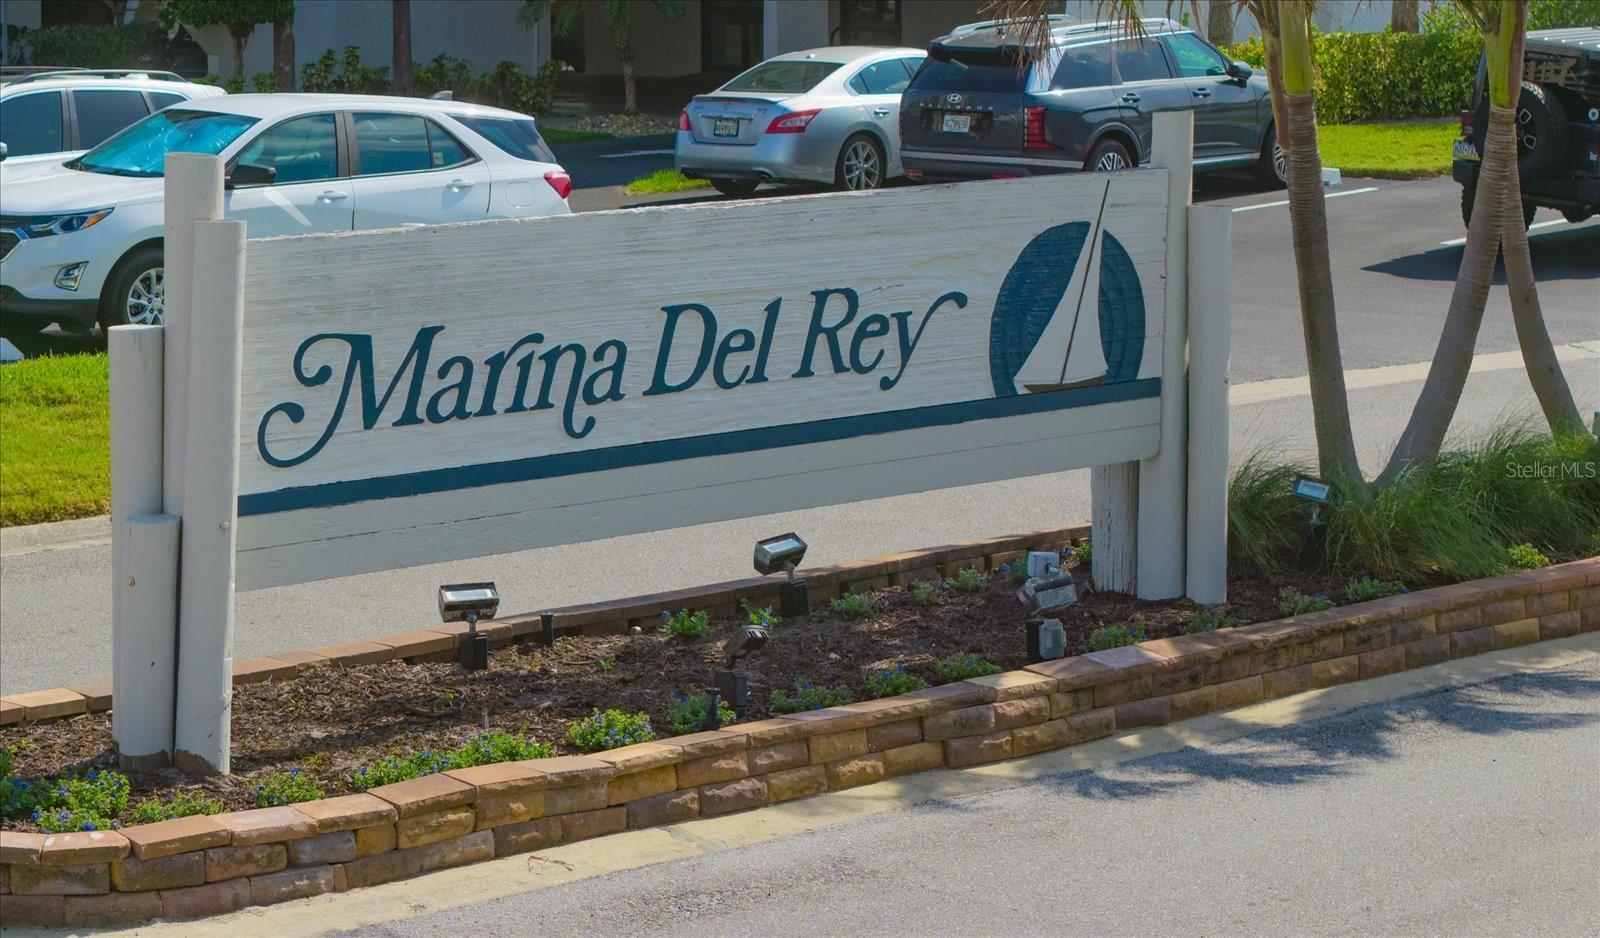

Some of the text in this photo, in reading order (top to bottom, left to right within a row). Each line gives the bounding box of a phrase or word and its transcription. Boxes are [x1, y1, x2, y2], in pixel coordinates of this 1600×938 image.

[257, 287, 969, 468] Marina Del Rey
